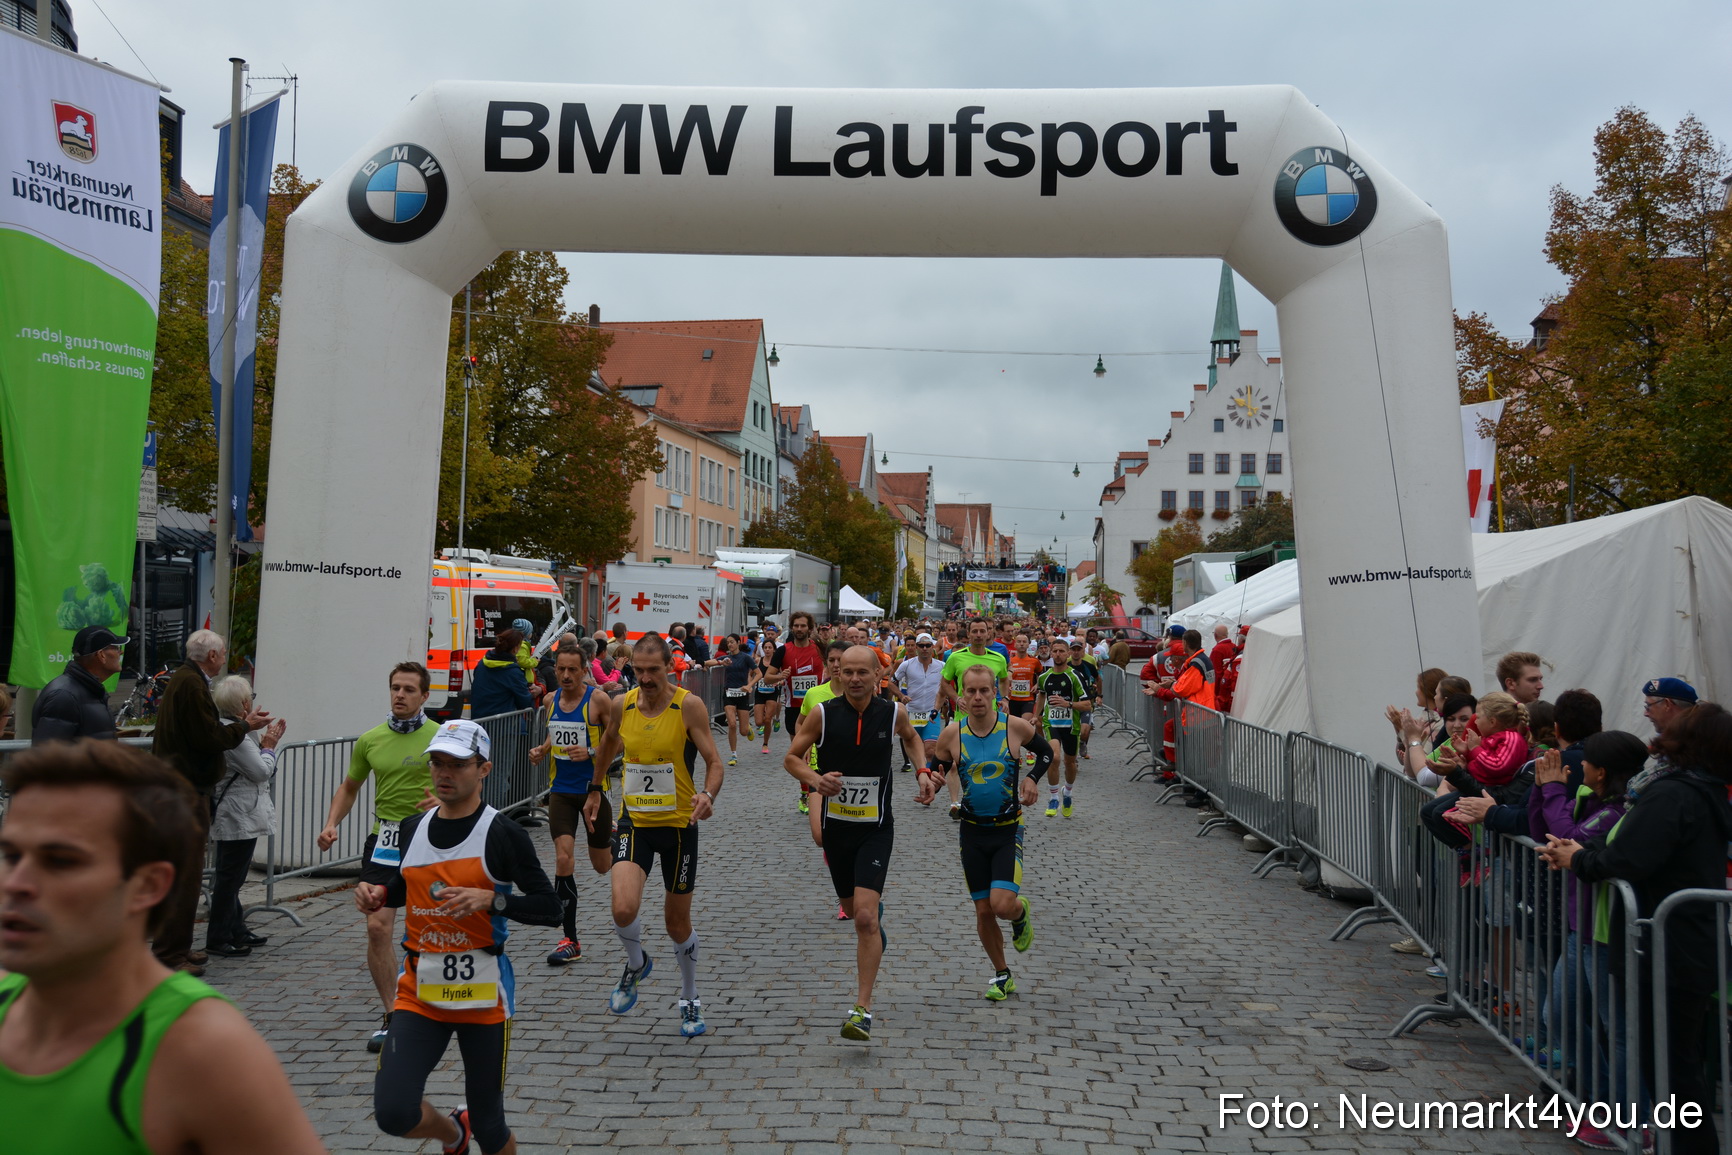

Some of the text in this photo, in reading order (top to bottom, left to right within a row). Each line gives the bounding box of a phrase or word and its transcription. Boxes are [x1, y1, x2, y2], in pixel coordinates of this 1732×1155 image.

[484, 100, 1240, 196] BMW Laufsport
[361, 146, 441, 177] BMW
[1283, 148, 1366, 180] BMW
[265, 560, 402, 579] www.bmw-laufsport.de
[1328, 566, 1472, 585] www.bmw-laufsport.de
[653, 592, 689, 600] Bayerisches
[794, 680, 816, 690] 2186
[1050, 709, 1070, 719] 3014
[555, 730, 579, 745] 203
[643, 775, 654, 793] 2
[636, 797, 663, 805] Thomas
[838, 787, 869, 805] 372
[839, 806, 866, 816] Thomas
[443, 954, 475, 981] 83
[442, 987, 473, 1001] Hynek
